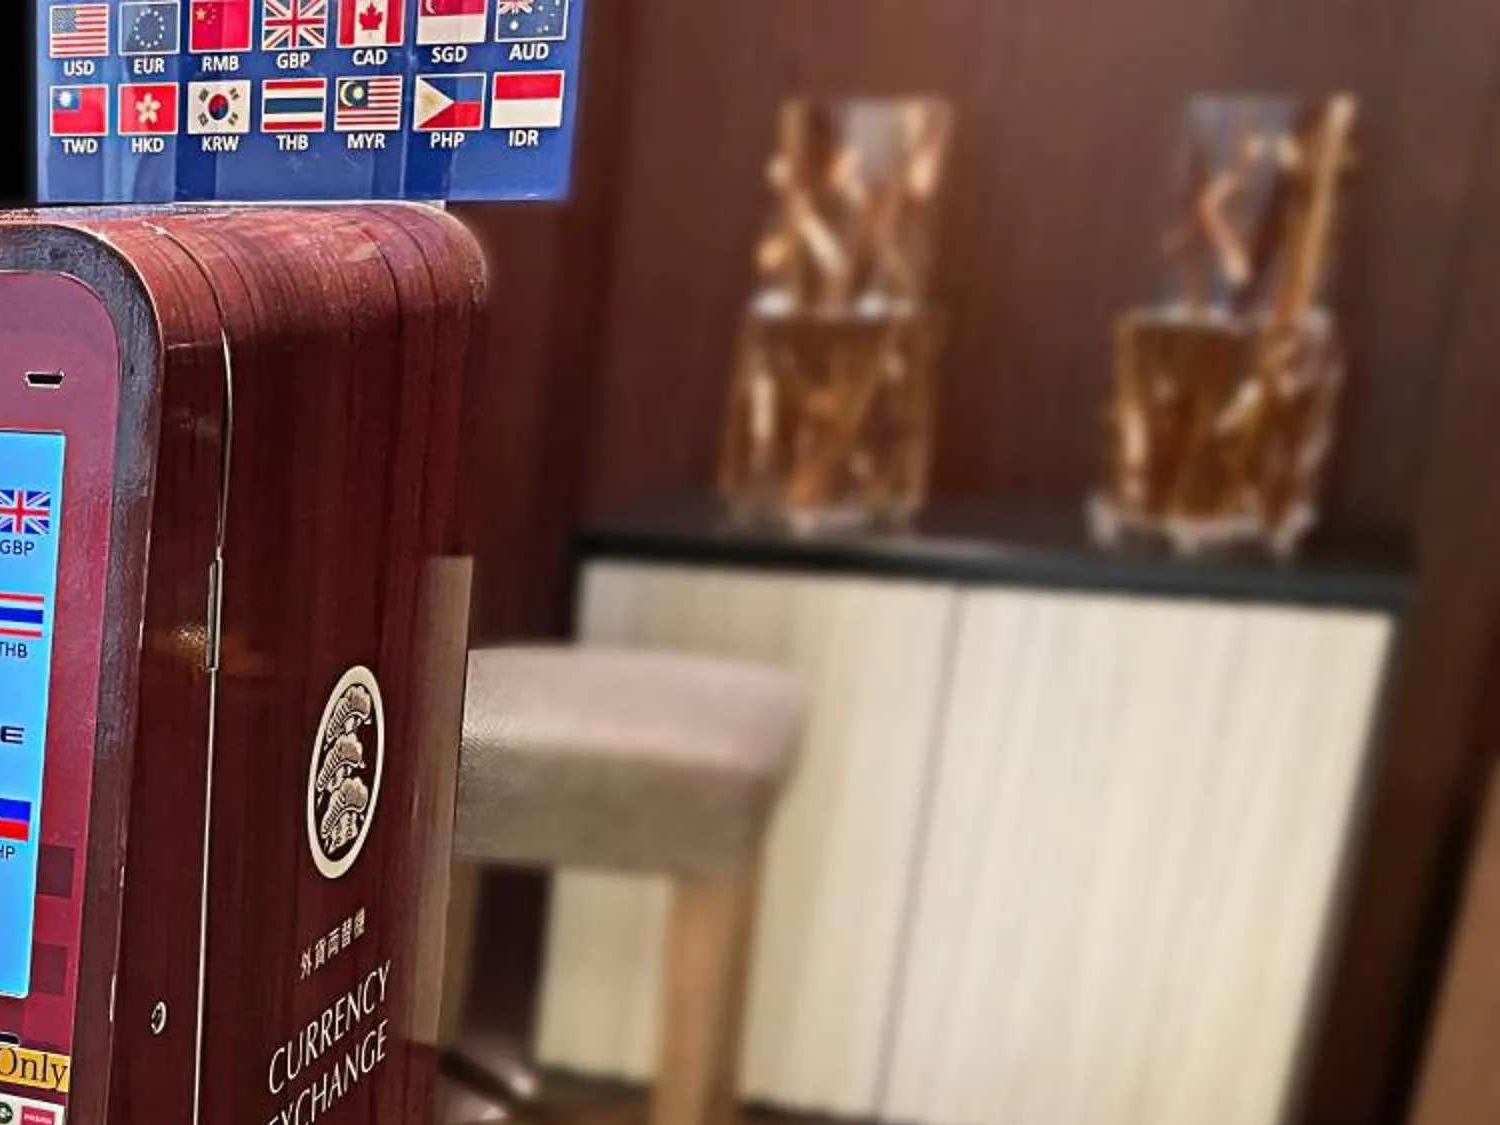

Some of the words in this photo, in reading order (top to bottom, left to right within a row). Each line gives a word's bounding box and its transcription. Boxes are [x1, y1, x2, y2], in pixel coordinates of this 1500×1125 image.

[276, 52, 310, 70] GBP
[352, 49, 388, 67] CAD
[431, 46, 468, 64] SGD
[509, 43, 549, 61] AUD
[63, 59, 95, 76] USD
[133, 57, 165, 74] EUR
[202, 55, 240, 73] RMB
[62, 138, 98, 154] TWD
[131, 137, 165, 154] HKD
[201, 135, 240, 152] KRW
[276, 133, 309, 151] THB
[347, 132, 386, 149] MYR
[430, 131, 465, 149] PHP
[509, 129, 539, 147] IDR
[0, 539, 35, 557] GBP
[268, 959, 391, 1095] CURRENCY
